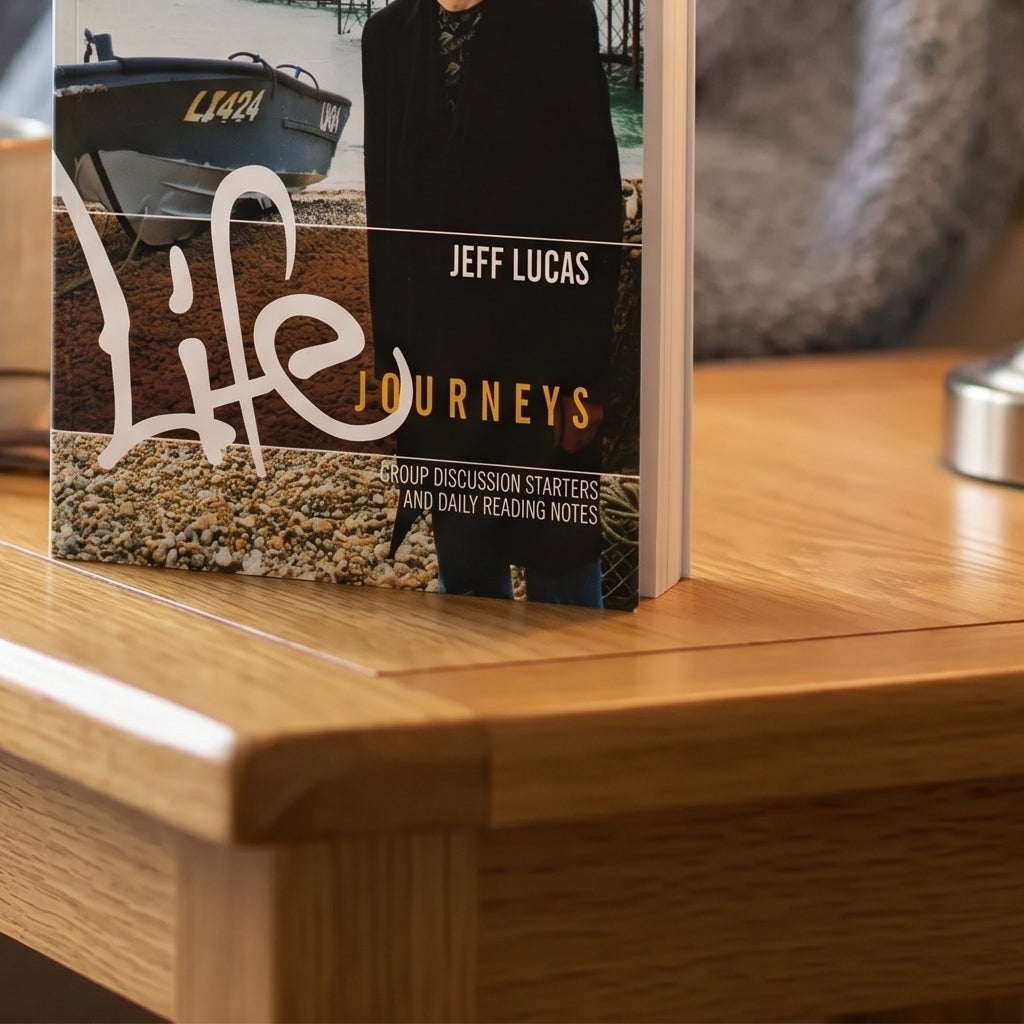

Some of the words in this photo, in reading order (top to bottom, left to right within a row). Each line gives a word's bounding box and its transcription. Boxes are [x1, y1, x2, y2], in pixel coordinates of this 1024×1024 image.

[449, 244, 504, 279] JEFF
[513, 248, 590, 286] LUCAS
[53, 150, 414, 478] Life
[354, 370, 589, 429] JOURNEYS
[379, 459, 429, 485] GROUP
[434, 467, 521, 494] DISCUSSION
[526, 474, 599, 501] STARTERS
[403, 489, 433, 510] AND
[438, 492, 478, 514] DAILY
[483, 496, 546, 521] READING
[551, 502, 598, 525] NOTES
